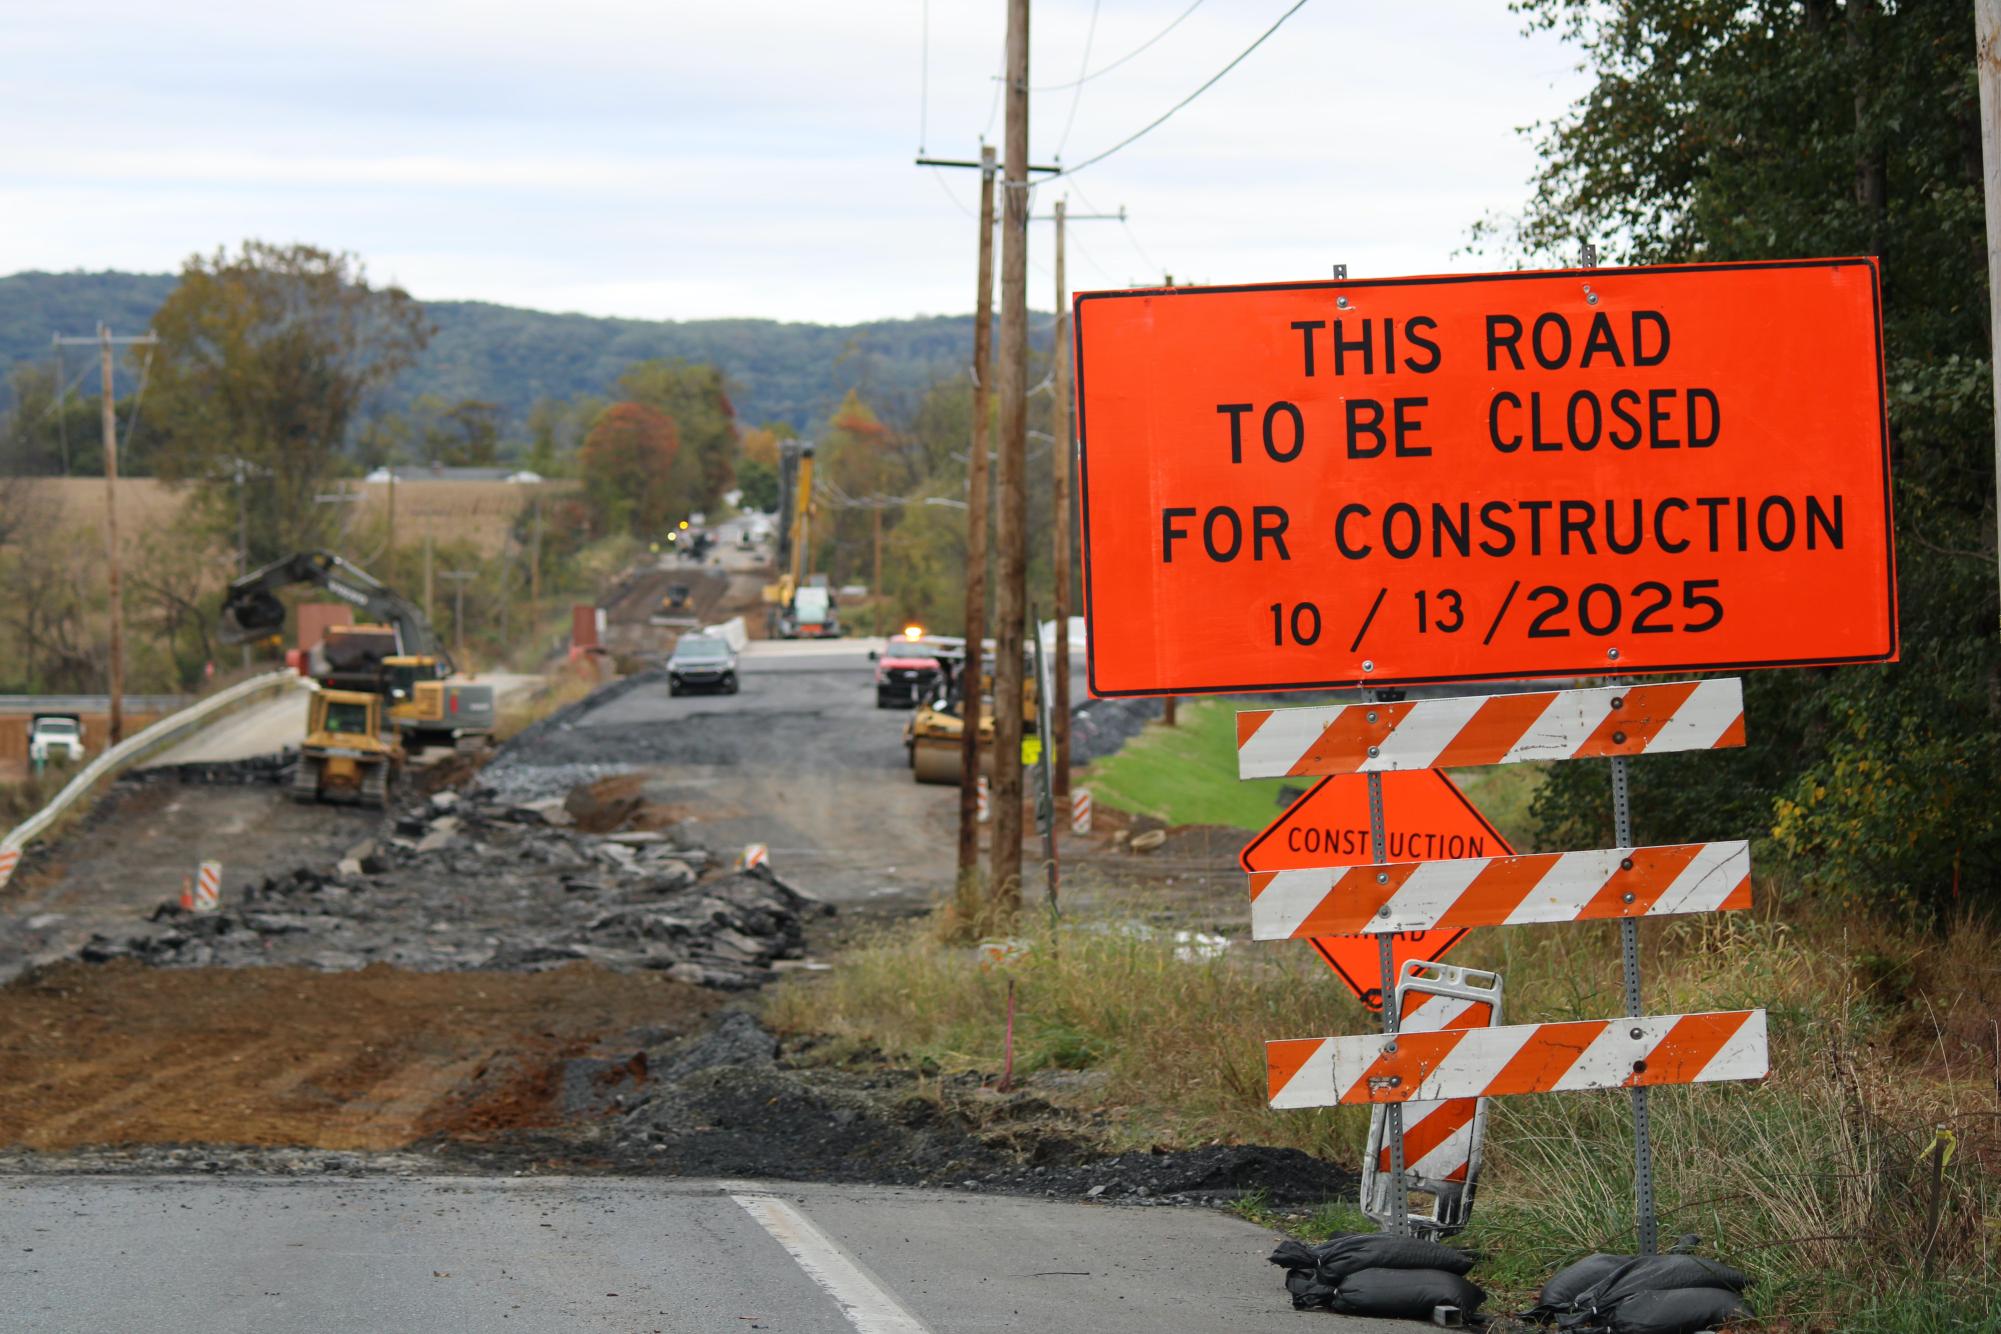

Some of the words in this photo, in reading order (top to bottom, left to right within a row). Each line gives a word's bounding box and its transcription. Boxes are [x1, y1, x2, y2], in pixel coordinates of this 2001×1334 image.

[1290, 315, 1442, 377] THIS
[1485, 310, 1671, 371] ROAD
[1216, 400, 1305, 464] TO
[1346, 396, 1433, 460] BE
[1488, 387, 1721, 454] CLOSED
[1162, 506, 1291, 564] FOR
[1334, 494, 1844, 561] CONSTRUCTION
[1287, 827, 1485, 860] CONSTUCTION
